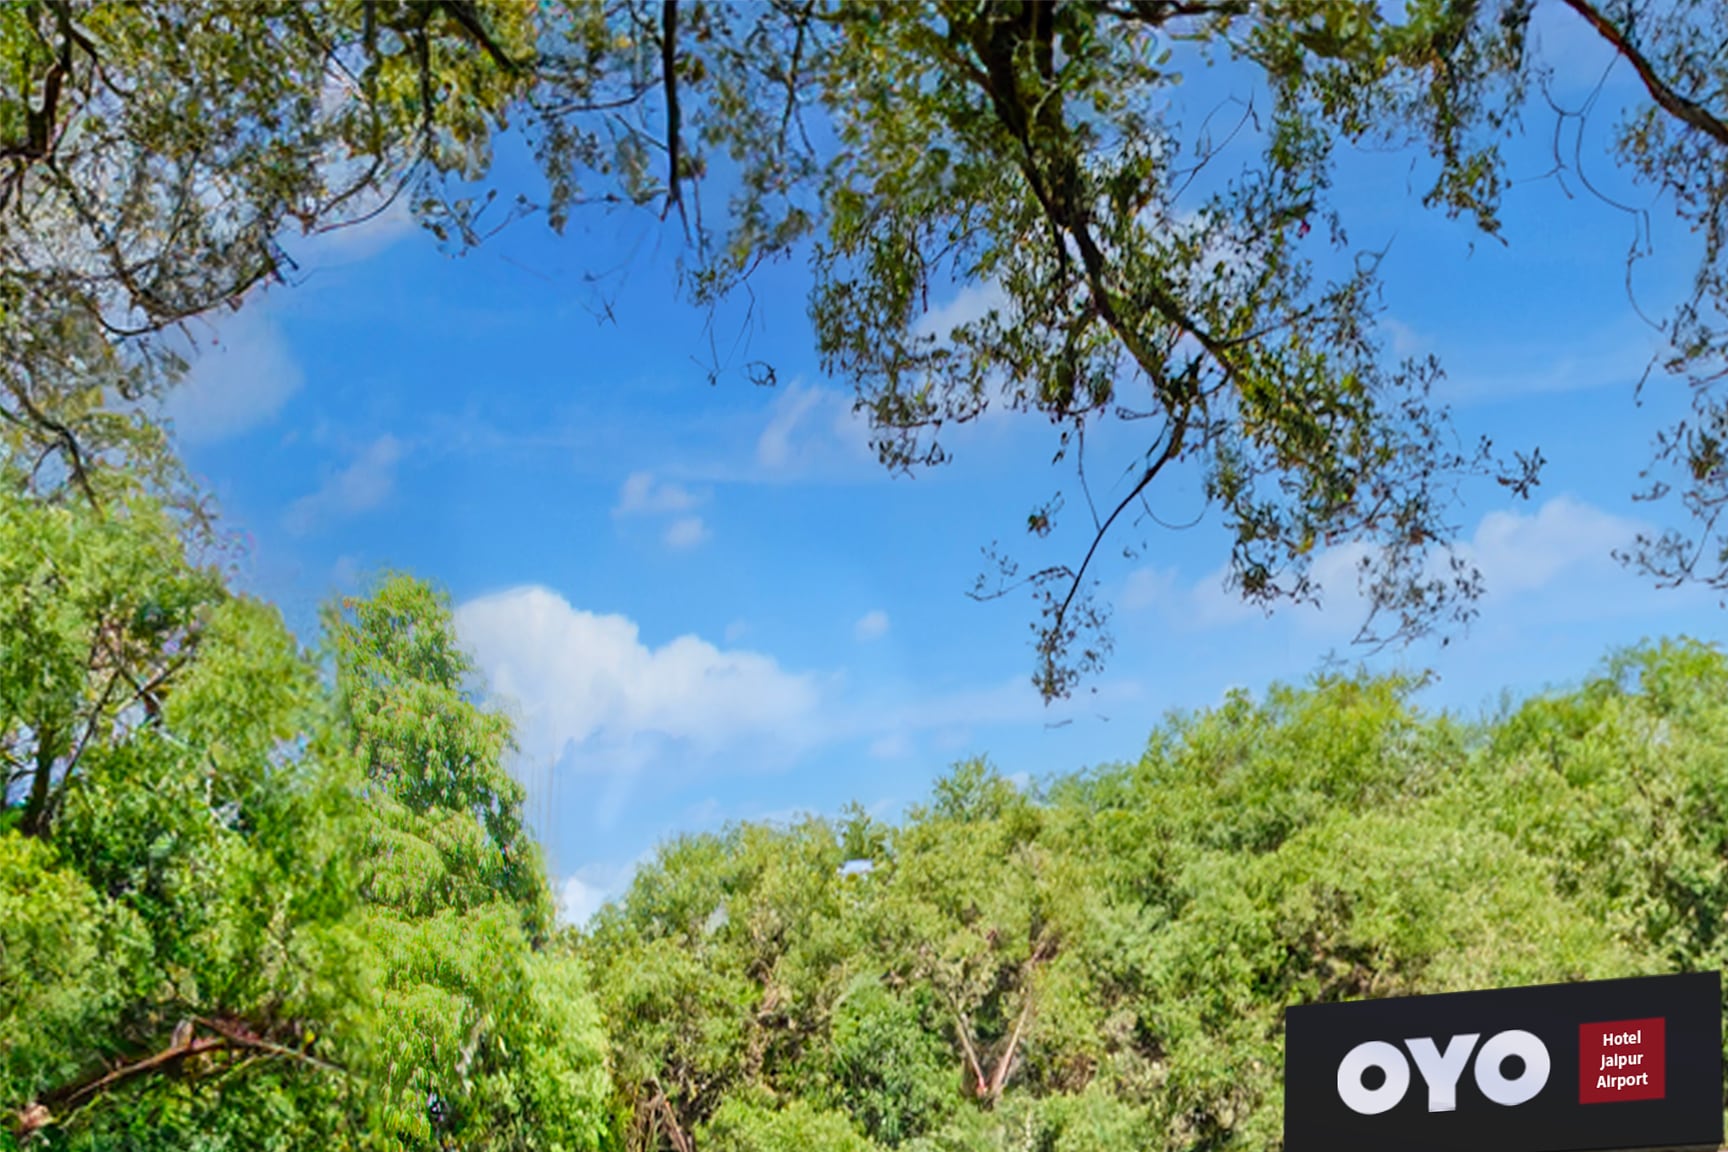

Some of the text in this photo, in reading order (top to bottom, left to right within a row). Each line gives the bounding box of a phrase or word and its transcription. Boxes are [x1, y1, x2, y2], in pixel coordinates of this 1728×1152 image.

[1602, 1029, 1641, 1047] Hotel
[1599, 1053, 1644, 1071] Jaipur
[1337, 1029, 1551, 1115] OYO
[1596, 1072, 1649, 1091] Airport
